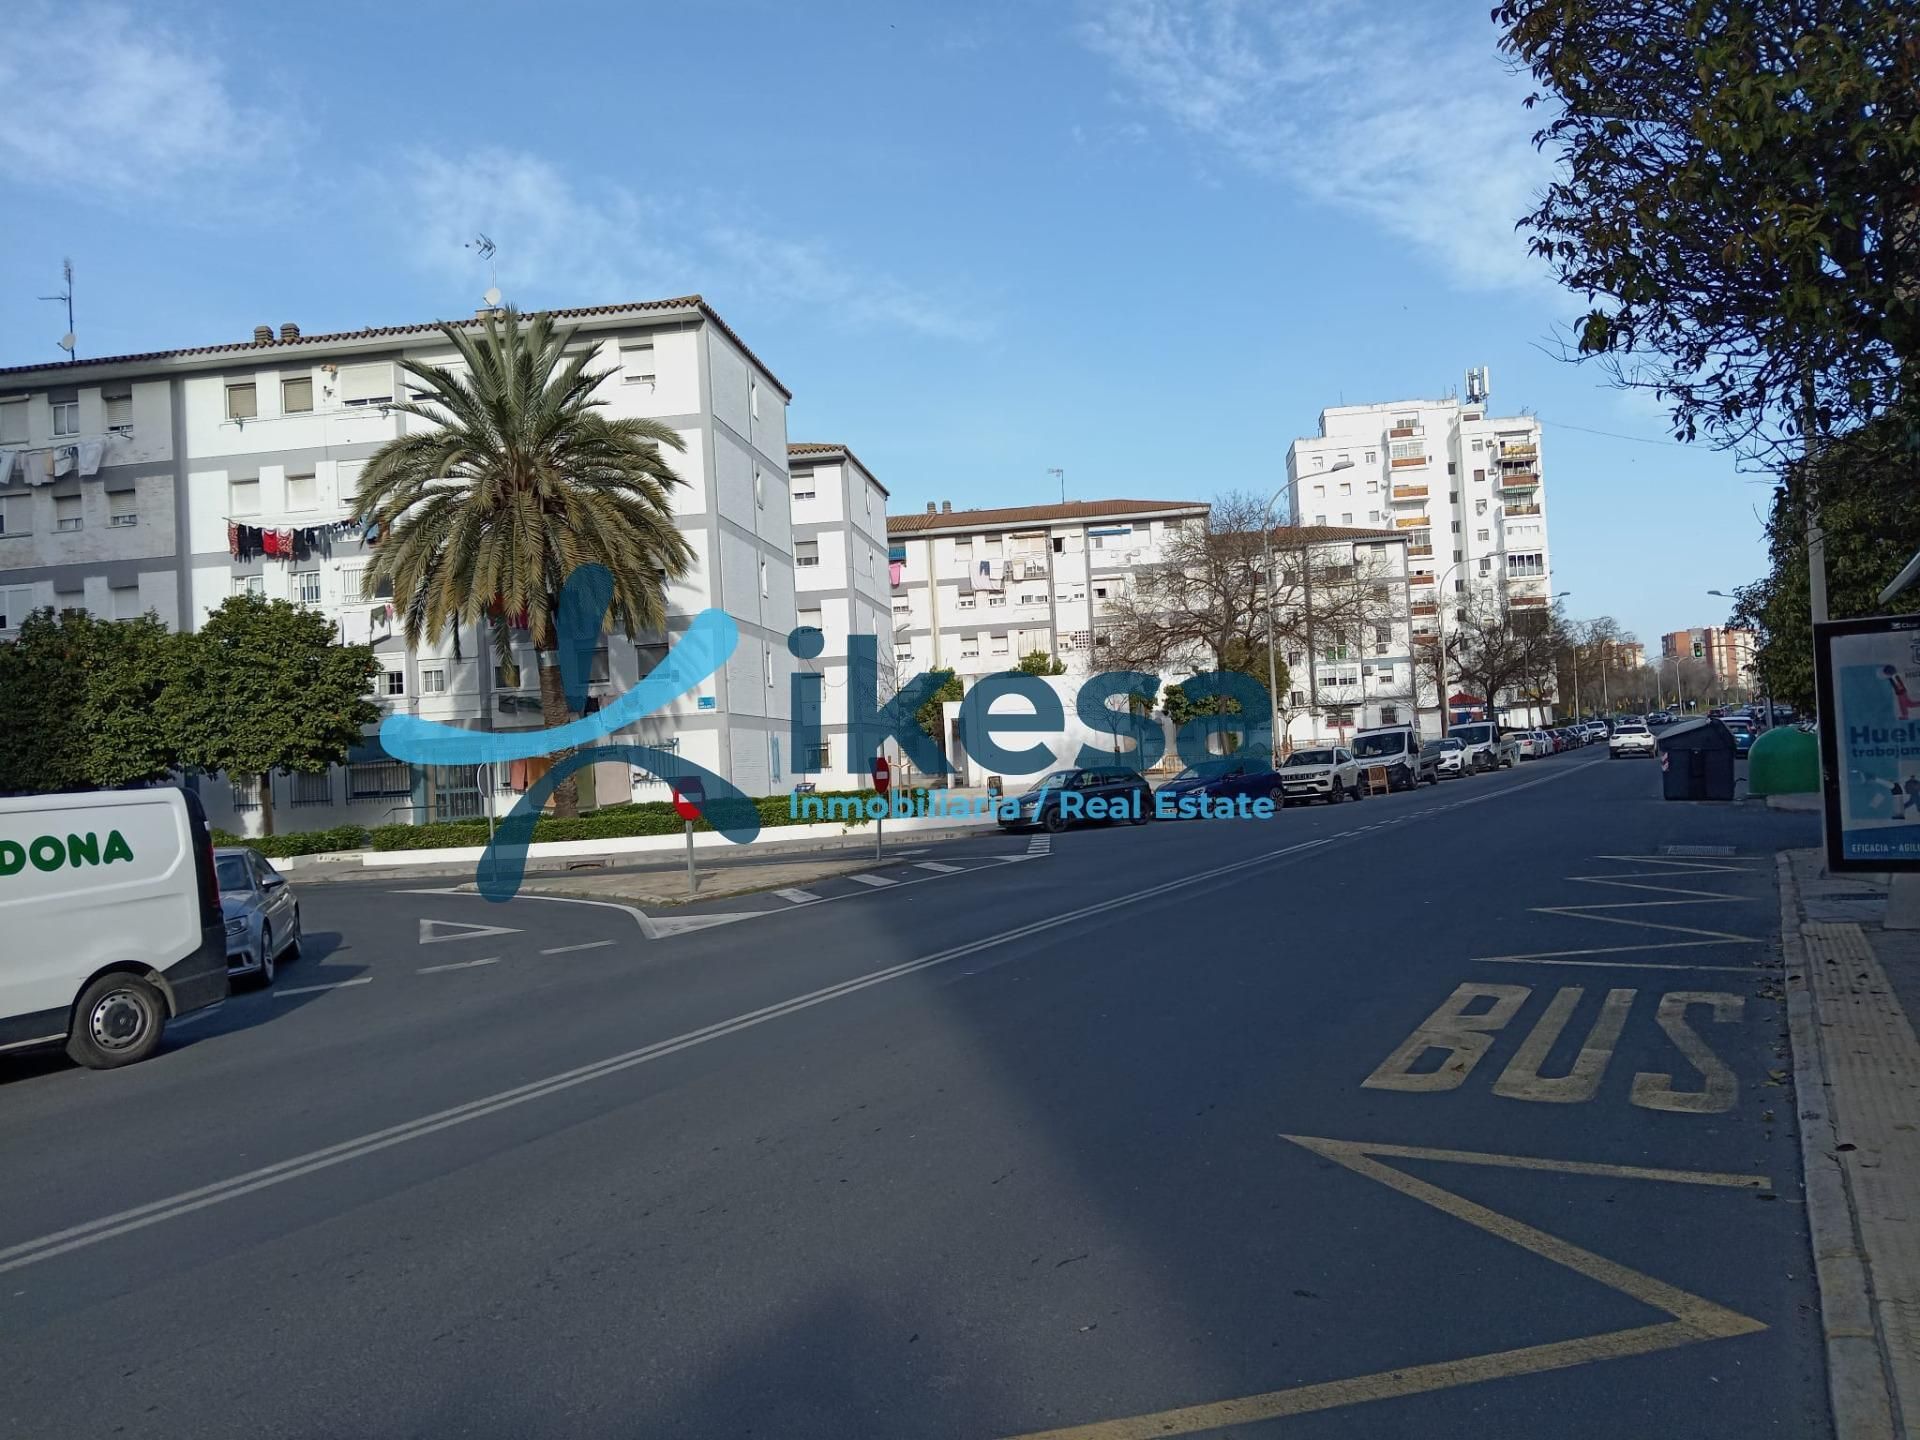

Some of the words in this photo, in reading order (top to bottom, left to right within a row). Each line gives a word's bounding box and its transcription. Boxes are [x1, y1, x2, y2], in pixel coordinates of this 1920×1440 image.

[1850, 722, 1920, 745] Huel
[0, 829, 134, 876] DONA
[1851, 843, 1889, 853] EFICACIA
[1360, 982, 1745, 1114] BUS
